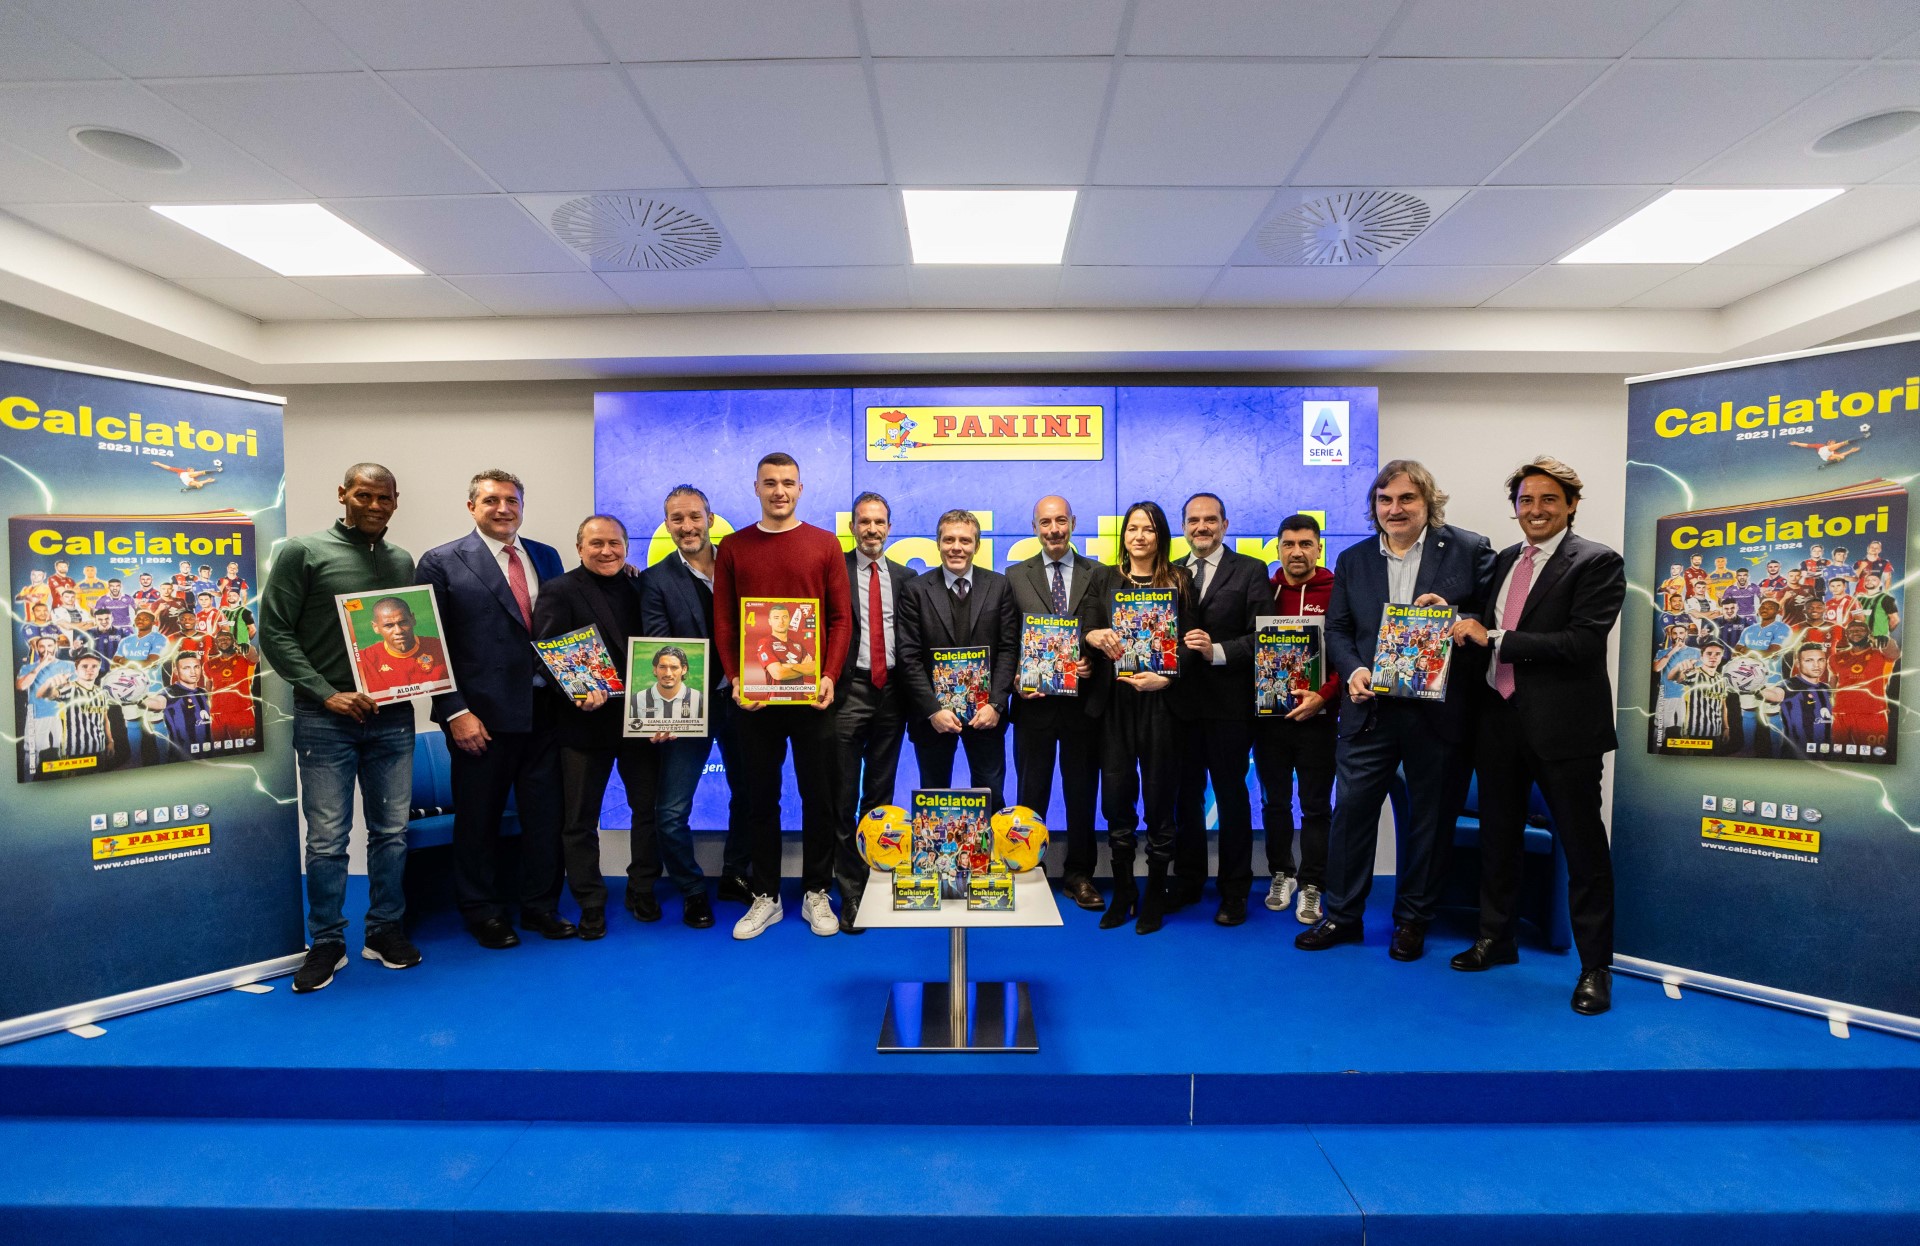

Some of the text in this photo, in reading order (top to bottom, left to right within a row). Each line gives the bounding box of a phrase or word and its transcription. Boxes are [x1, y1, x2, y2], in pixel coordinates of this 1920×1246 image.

[1654, 376, 1920, 438] Calciatori
[0, 396, 257, 457] Calciatori
[933, 414, 1091, 438] PANINI
[1736, 430, 1769, 441] 2023
[1779, 425, 1813, 437] 2024
[98, 442, 132, 454] 2023
[142, 446, 174, 458] 2024
[1309, 448, 1343, 457] SERIE A
[1671, 506, 1889, 550] Calciatori
[28, 529, 242, 555] Calciatori
[1739, 544, 1767, 553] 2023
[1775, 542, 1803, 550] 2024
[1115, 591, 1172, 602] Calciatori
[746, 611, 756, 627] 4
[1386, 605, 1453, 619] Calciatori
[1026, 615, 1079, 627] Calciatori
[537, 627, 596, 649] Calciatori
[1259, 633, 1310, 644] Calciatori
[933, 649, 986, 661] Calciatori
[397, 685, 421, 694] ALDAIR
[915, 794, 986, 807] Calciatori
[128, 827, 204, 846] PANINI
[1734, 824, 1814, 843] PANINI
[94, 848, 211, 871] www.calciatoripanini.it
[1701, 841, 1819, 864] www.calciatoripanini.it
